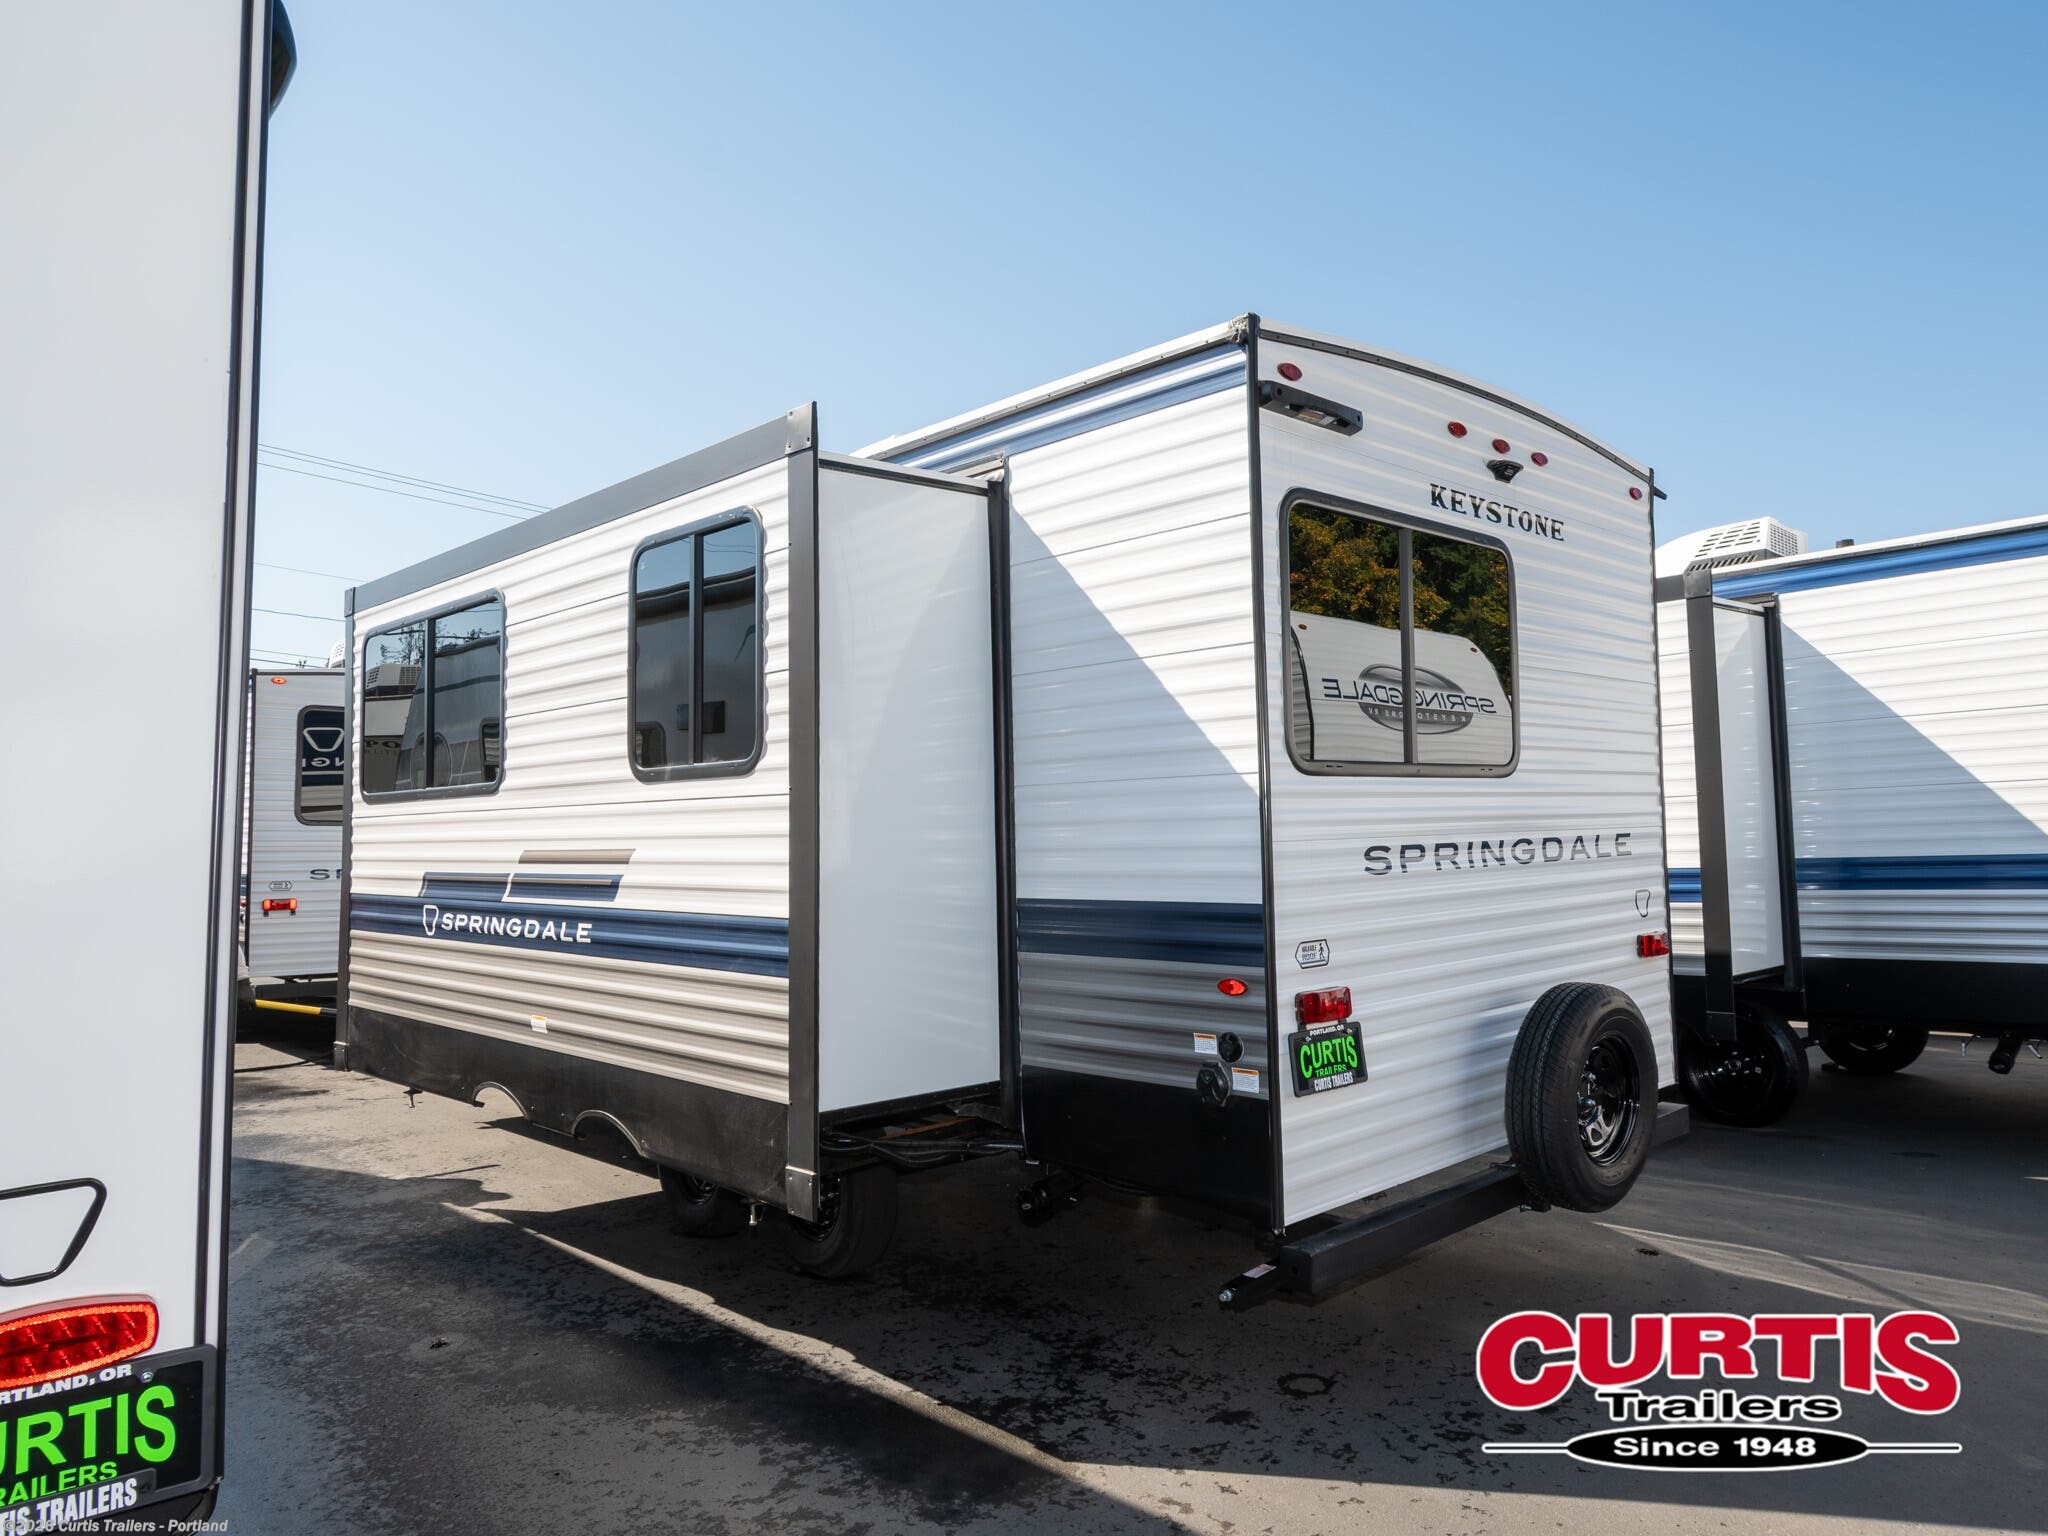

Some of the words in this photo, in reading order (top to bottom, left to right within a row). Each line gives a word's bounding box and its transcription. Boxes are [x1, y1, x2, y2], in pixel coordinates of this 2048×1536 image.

[1429, 482, 1565, 542] KEYSTONE
[1364, 832, 1632, 876] SPRINGDALE
[440, 911, 592, 944] SPRINGDALE
[1300, 1035, 1358, 1079] CURTIS
[1315, 1064, 1347, 1077] TRAILERS
[99, 1364, 133, 1382] OR
[36, 1478, 138, 1528] TRAILERS
